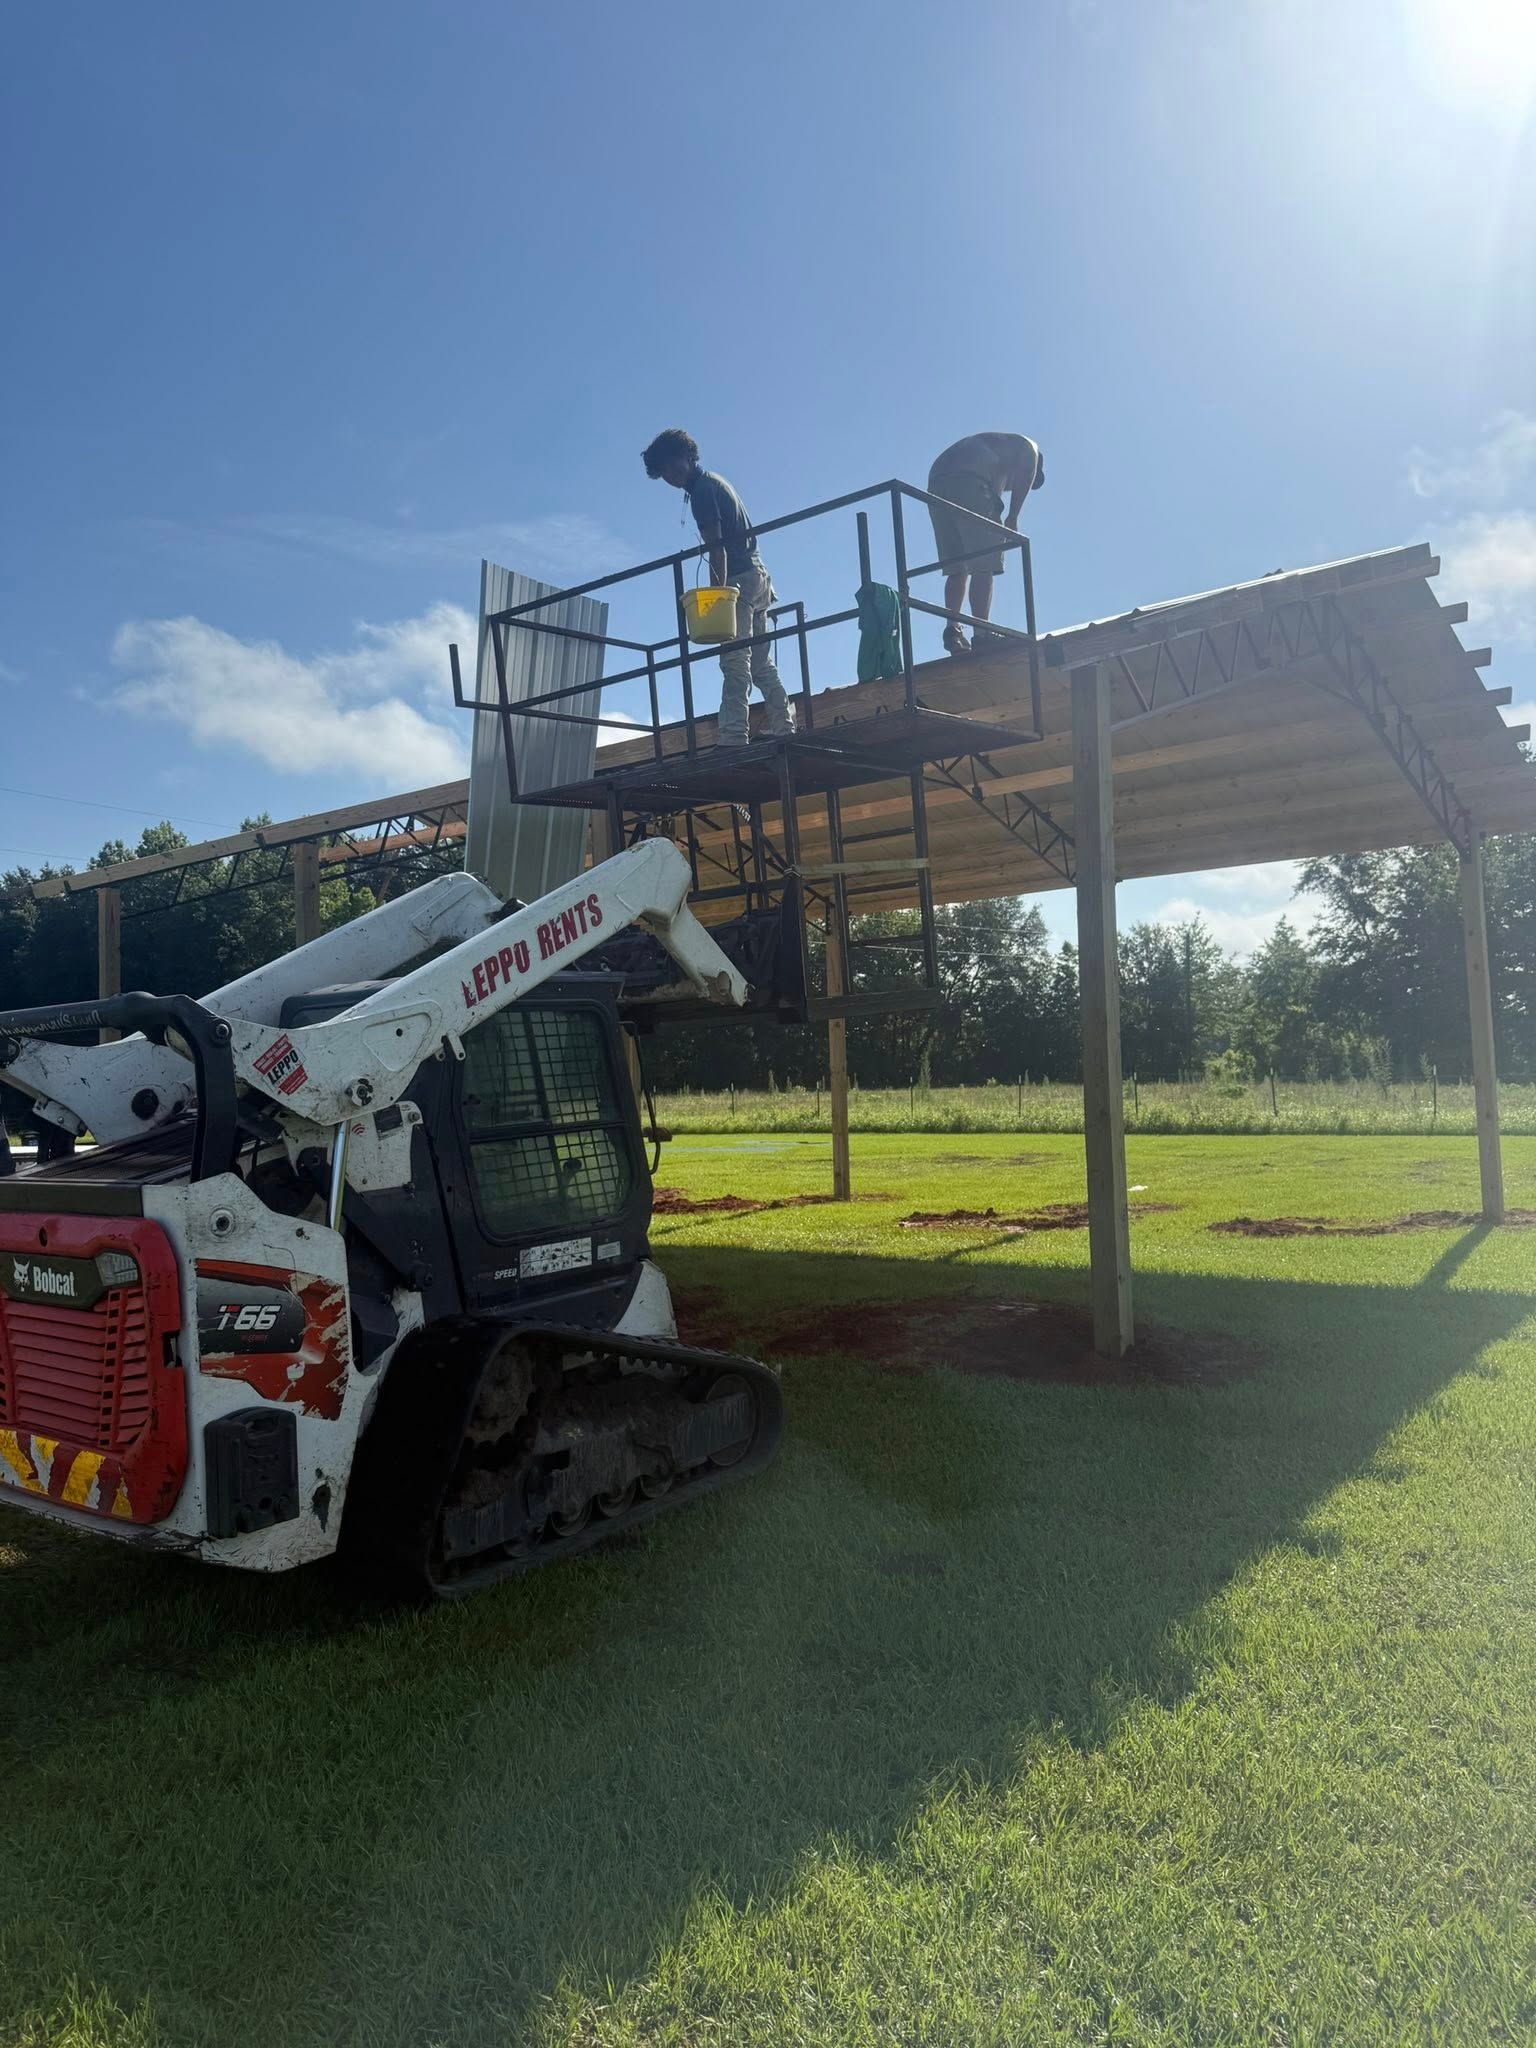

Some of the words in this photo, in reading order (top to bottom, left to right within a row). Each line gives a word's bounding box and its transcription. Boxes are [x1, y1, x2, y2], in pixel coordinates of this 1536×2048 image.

[461, 939, 530, 1009] LEPPO
[536, 893, 603, 961] RENTS
[267, 1049, 299, 1085] LEPPO
[33, 1266, 75, 1297] Bobcat
[494, 1267, 518, 1280] SPEED
[217, 1305, 281, 1330] T66
